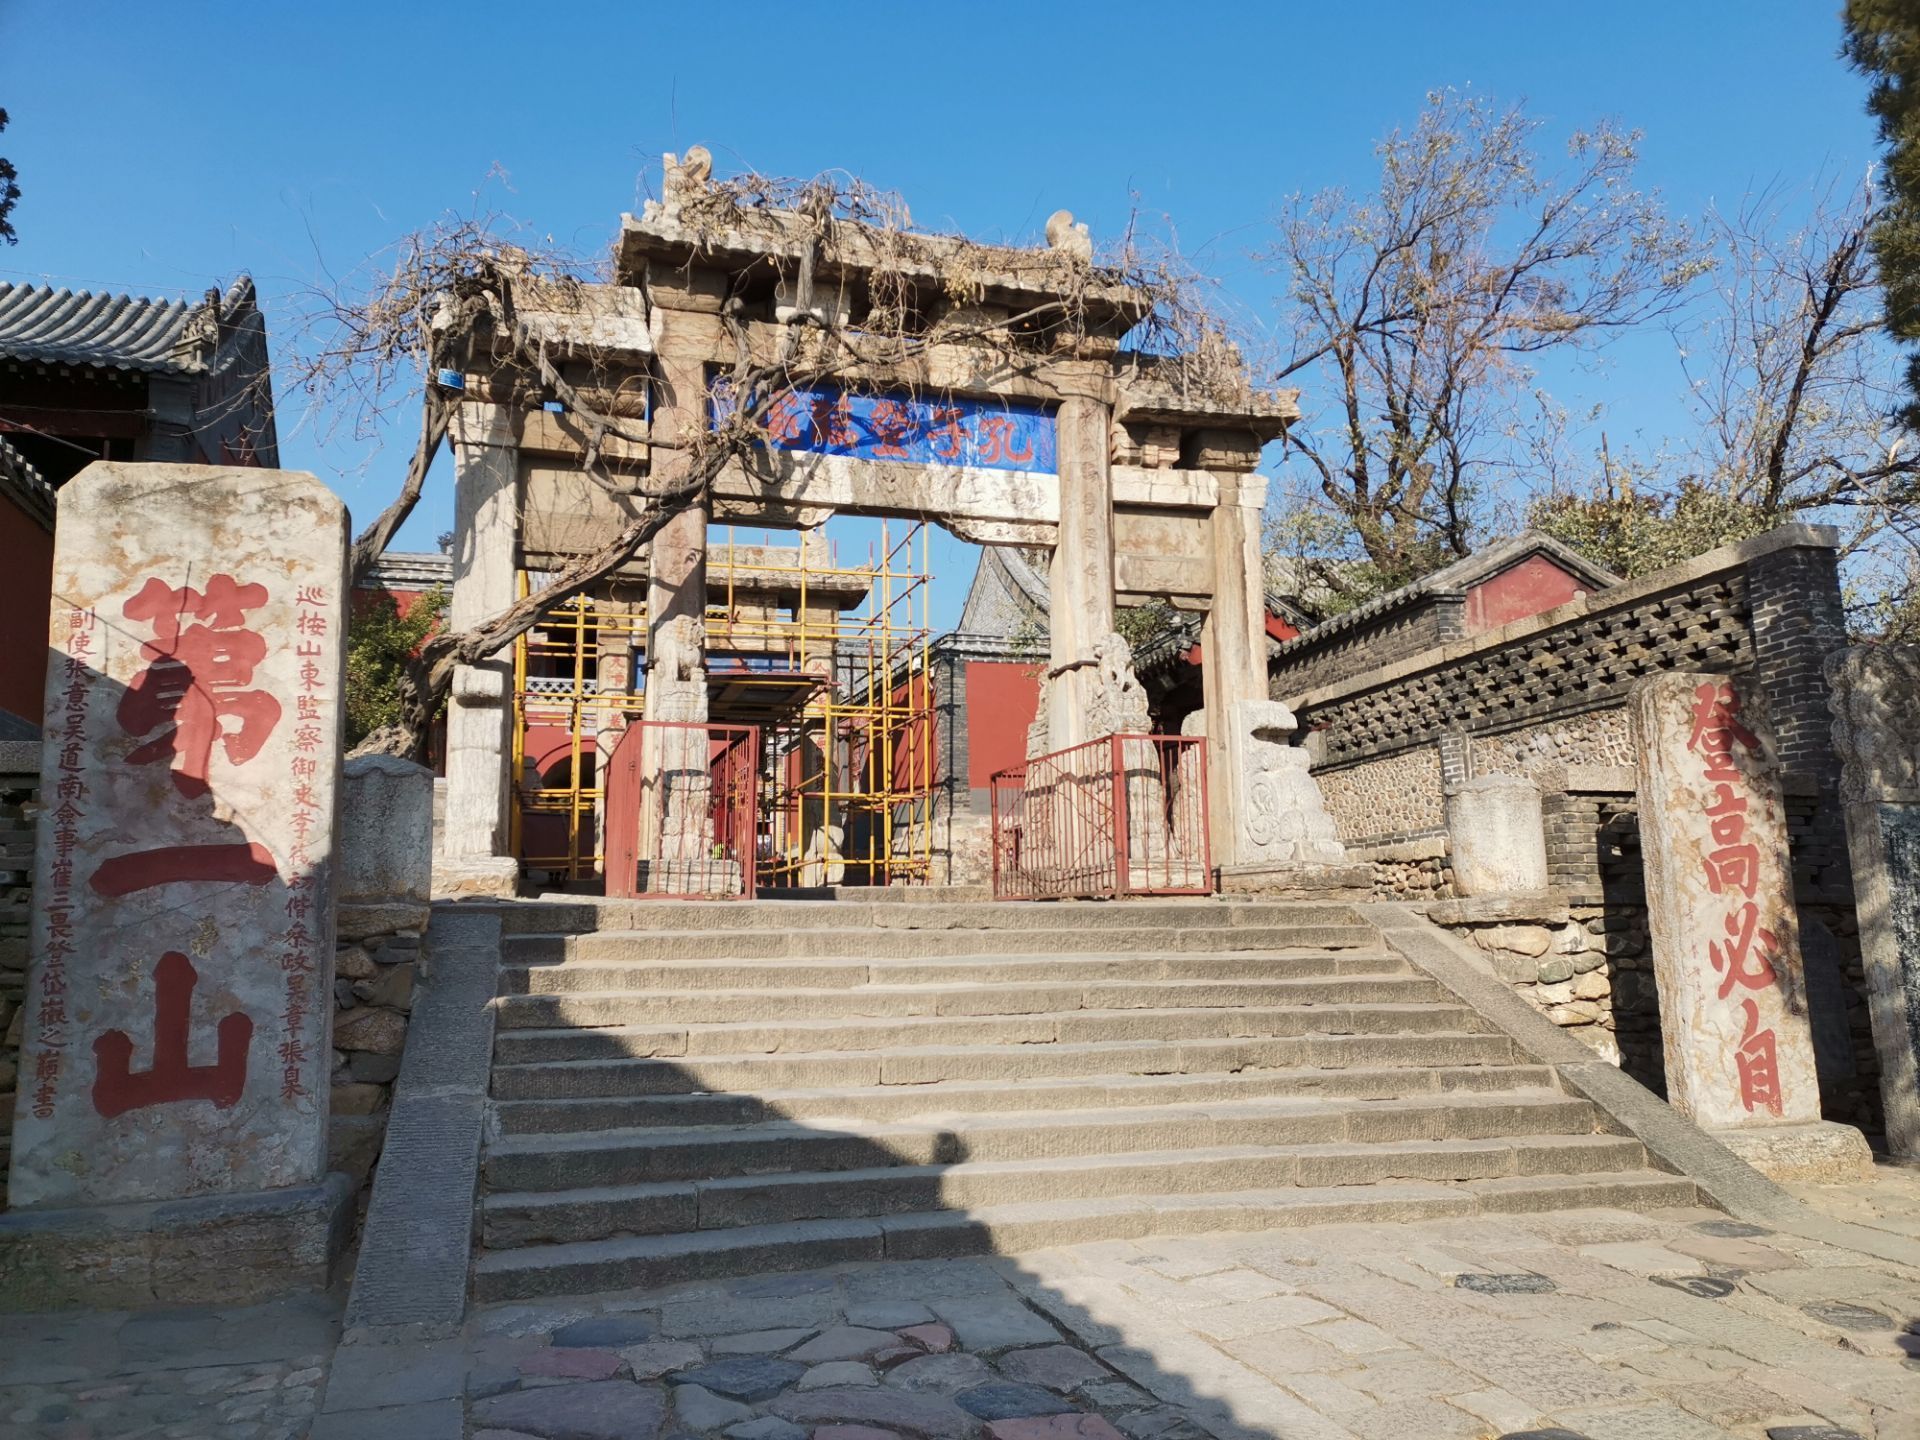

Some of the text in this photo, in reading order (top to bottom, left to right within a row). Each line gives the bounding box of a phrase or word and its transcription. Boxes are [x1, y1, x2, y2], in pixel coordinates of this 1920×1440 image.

[88, 573, 282, 1118] 第一山
[1686, 681, 1783, 1117] 登高必自
